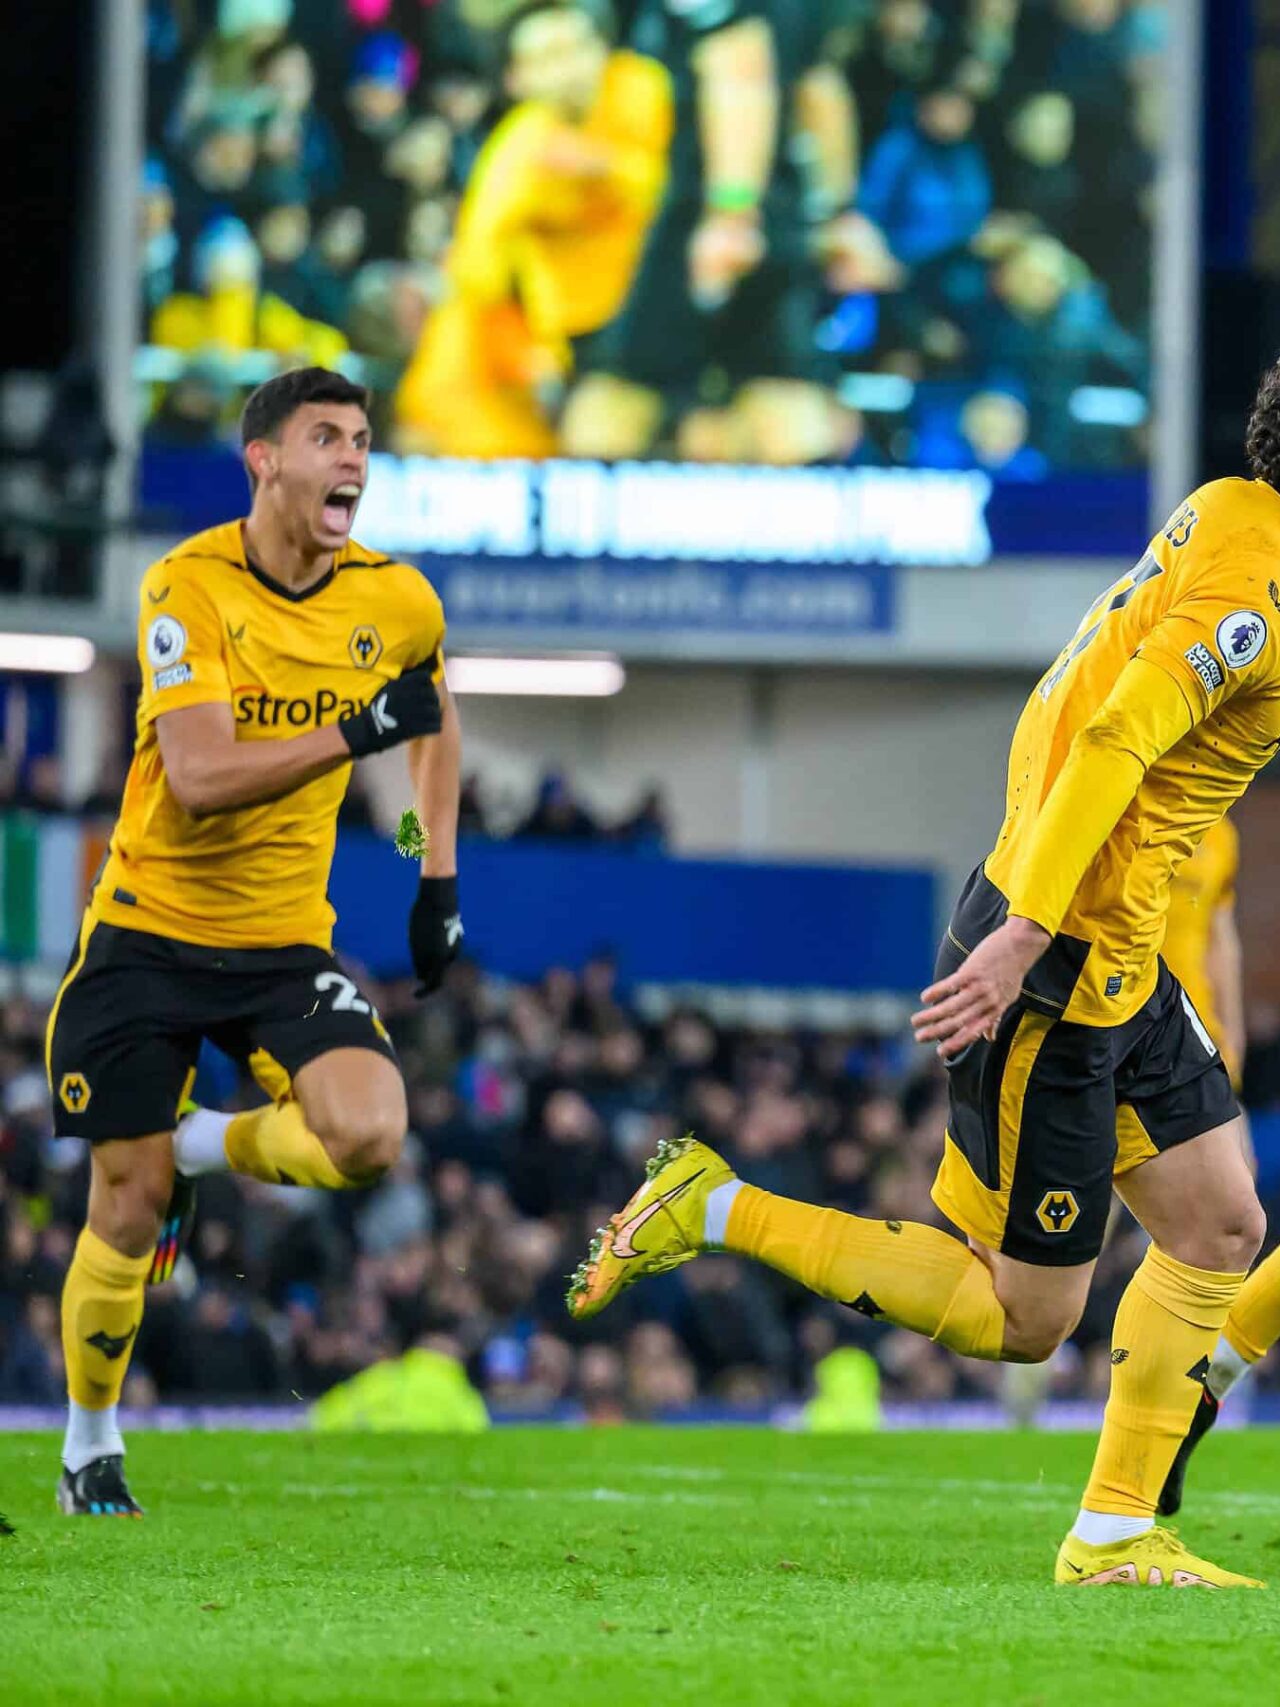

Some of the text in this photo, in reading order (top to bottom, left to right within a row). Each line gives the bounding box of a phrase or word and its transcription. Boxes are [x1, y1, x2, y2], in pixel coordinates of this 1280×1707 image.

[1192, 641, 1221, 685] No room
[235, 689, 364, 727] stroPa
[314, 970, 379, 1019] 2
